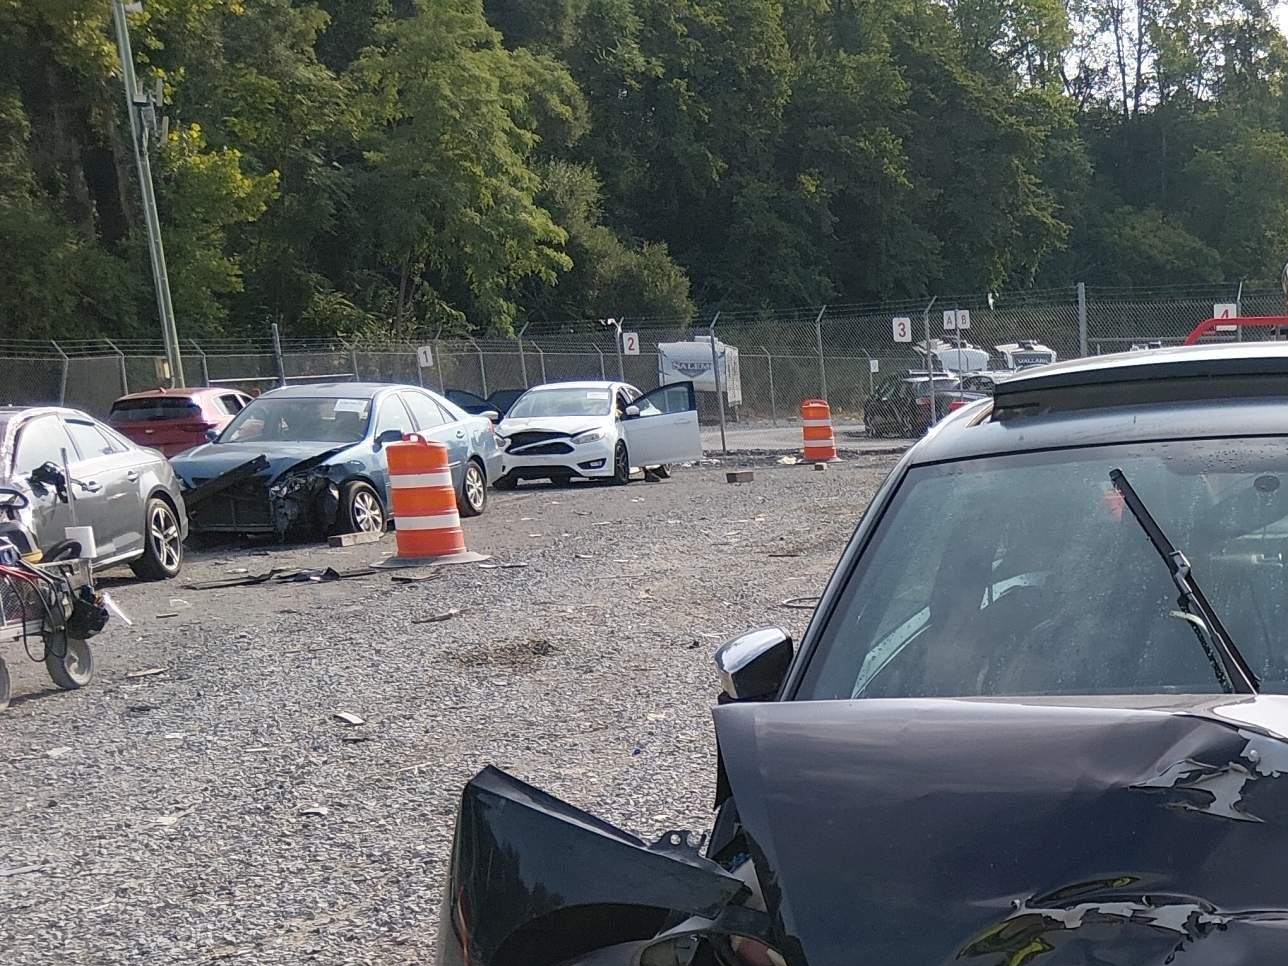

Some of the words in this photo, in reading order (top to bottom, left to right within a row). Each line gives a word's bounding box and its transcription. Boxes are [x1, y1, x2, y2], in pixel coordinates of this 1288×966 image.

[946, 315, 953, 325] A
[961, 314, 967, 325] B
[898, 322, 907, 338] 3
[628, 337, 635, 351] 2
